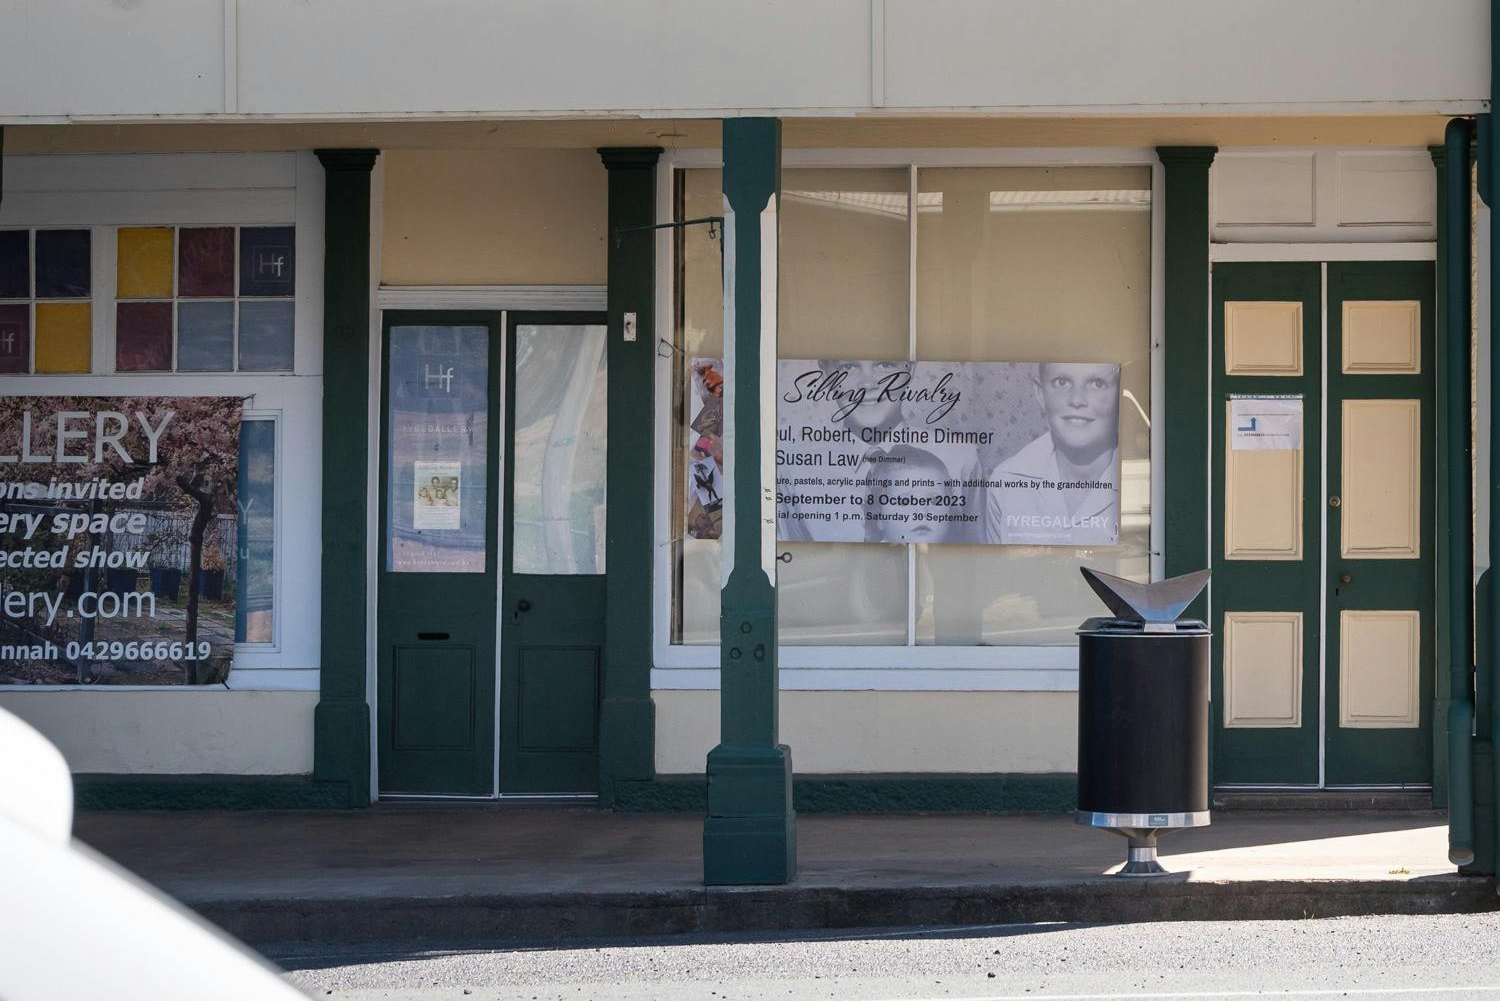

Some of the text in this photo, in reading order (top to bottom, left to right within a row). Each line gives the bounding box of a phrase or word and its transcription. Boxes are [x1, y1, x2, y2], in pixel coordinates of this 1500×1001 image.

[783, 370, 961, 425] Sibling Rivalry
[0, 411, 176, 464] LERY
[776, 426, 994, 445] ul, Robert, Christine Dimmer
[776, 450, 822, 467] Susan
[828, 451, 860, 467] Law
[47, 476, 146, 500] invited
[794, 477, 825, 487] pastels,
[827, 477, 854, 488] acrylic
[856, 478, 893, 489] paintings
[895, 478, 910, 487] and
[912, 479, 935, 489] prints
[944, 479, 961, 487] with
[962, 479, 1002, 488] additional
[1004, 480, 1029, 489] works
[1031, 480, 1041, 490] by
[1042, 480, 1055, 489] the
[1057, 480, 1113, 491] grandchildren
[776, 493, 967, 507] September to 8 October 2023
[51, 513, 147, 540] space
[792, 511, 831, 522] opening
[843, 513, 863, 522] p.m.
[866, 512, 910, 523] Saturday
[912, 513, 924, 521] 30
[926, 513, 980, 524] September
[74, 546, 151, 569] show
[65, 641, 211, 661] 0429666619
